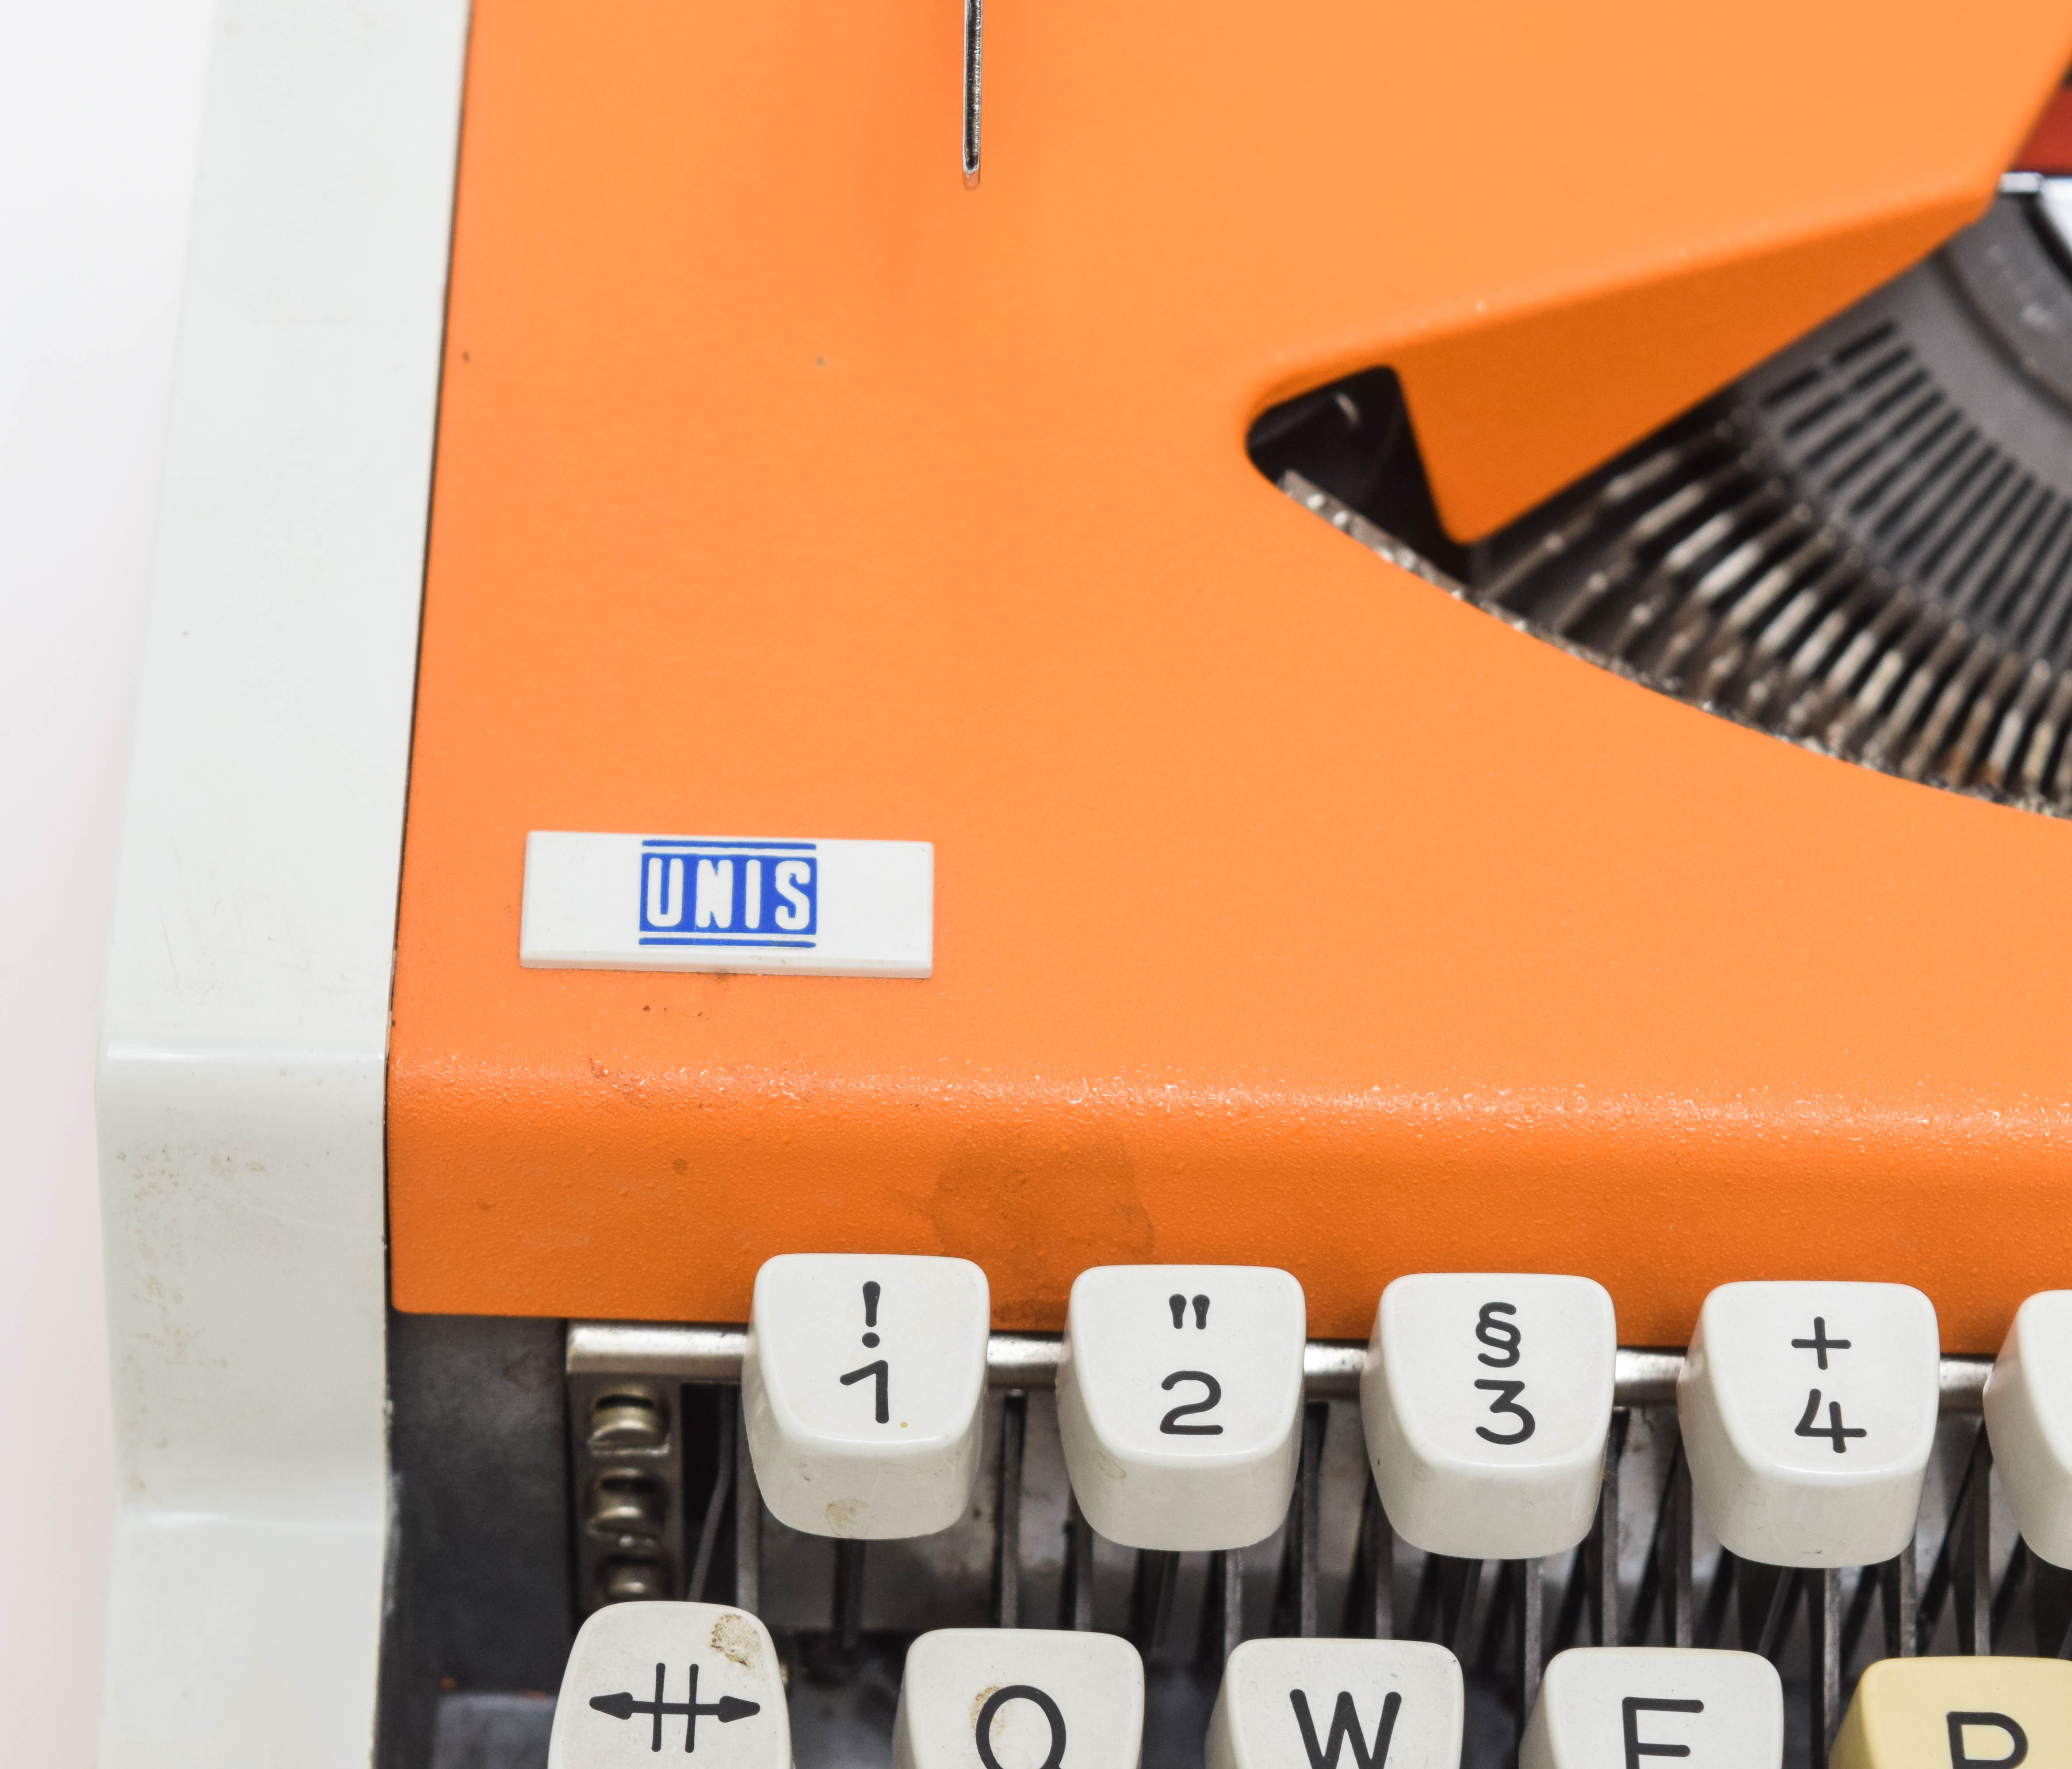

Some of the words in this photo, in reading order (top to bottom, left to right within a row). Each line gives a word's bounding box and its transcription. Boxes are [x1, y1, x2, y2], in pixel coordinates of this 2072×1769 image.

[647, 858, 811, 930] UNIS
[862, 1281, 881, 1348] !
[1475, 1302, 1522, 1368] §
[840, 1360, 890, 1424] 1
[1160, 1371, 1224, 1435] 2
[1474, 1379, 1536, 1445] 3
[1795, 1389, 1867, 1454] 4
[1289, 1689, 1402, 1769] W
